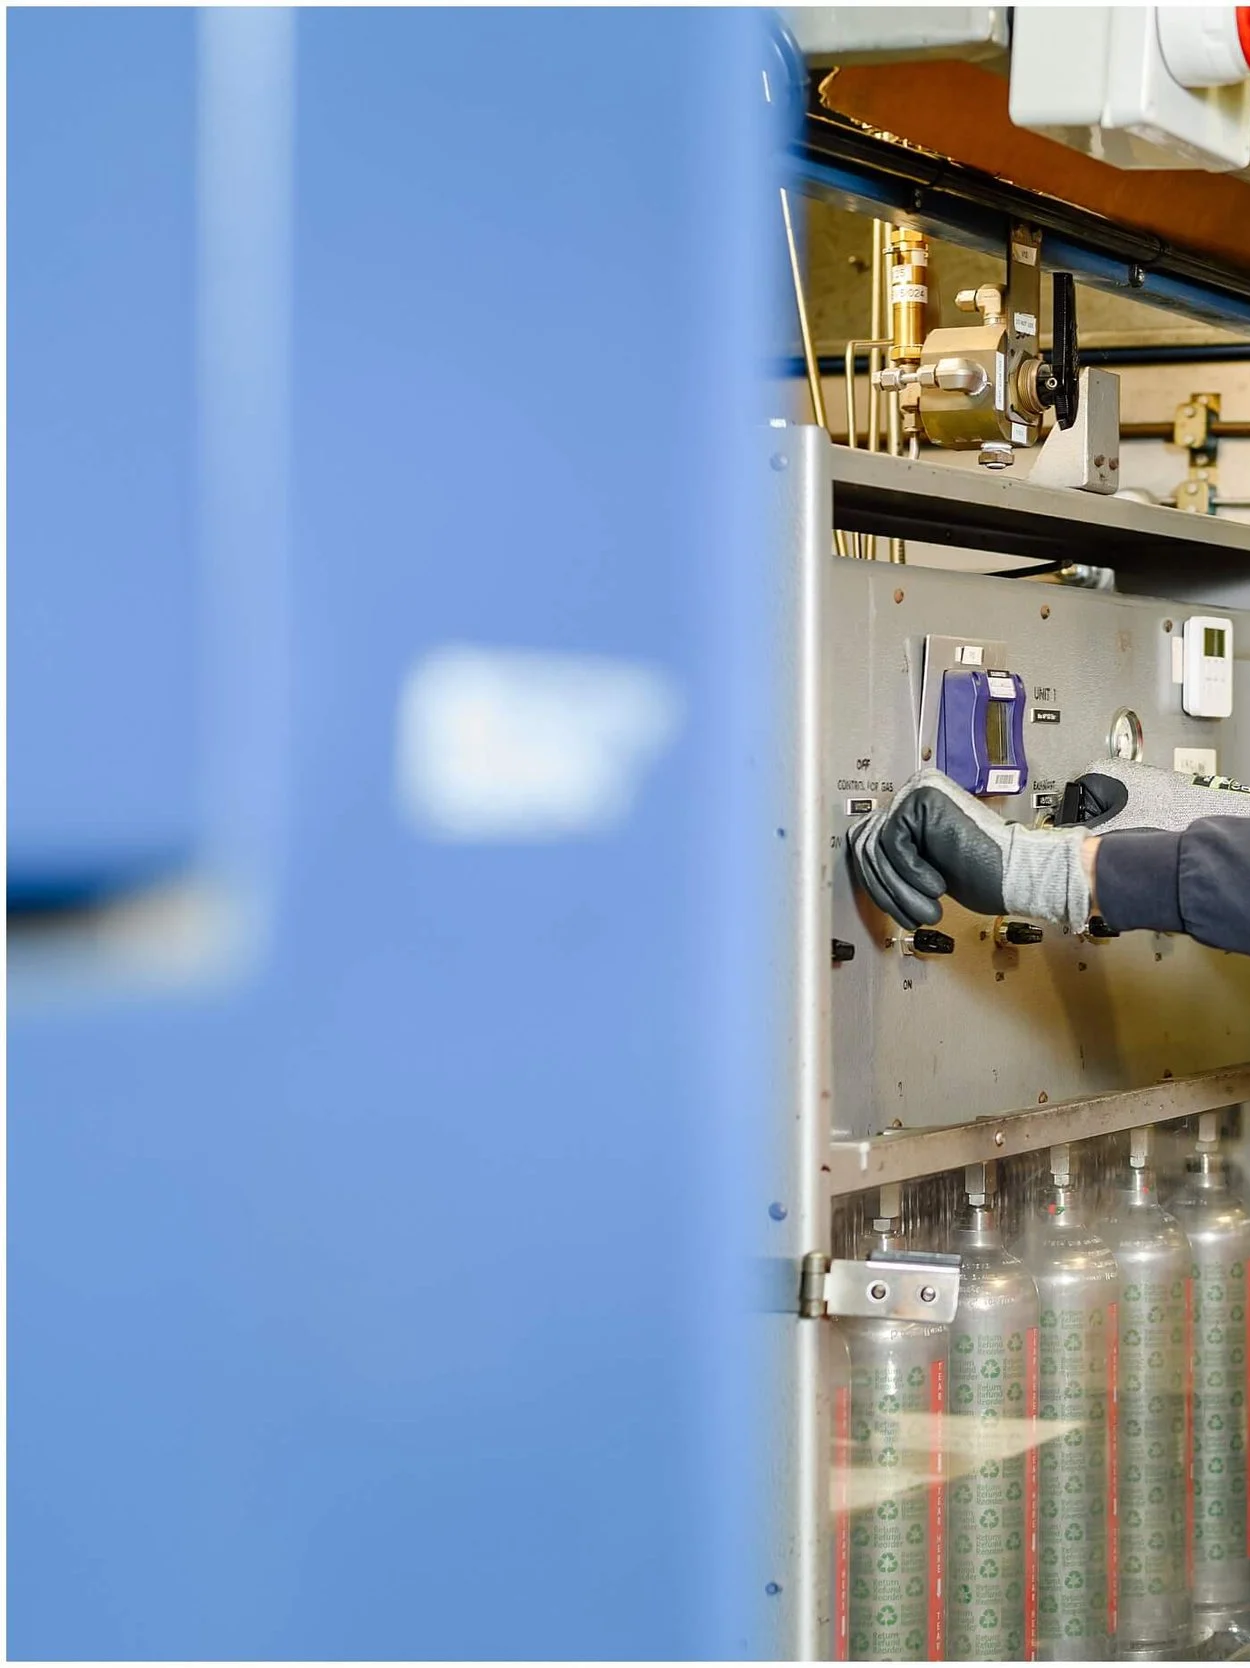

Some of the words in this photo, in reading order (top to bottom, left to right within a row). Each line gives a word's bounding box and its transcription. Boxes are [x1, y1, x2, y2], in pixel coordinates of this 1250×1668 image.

[1033, 686, 1051, 701] UNIT
[856, 758, 871, 770] OFF
[880, 781, 894, 793] GAS
[902, 979, 913, 990] ON
[936, 1362, 944, 1401] TEAR
[935, 1487, 943, 1526] TEAR
